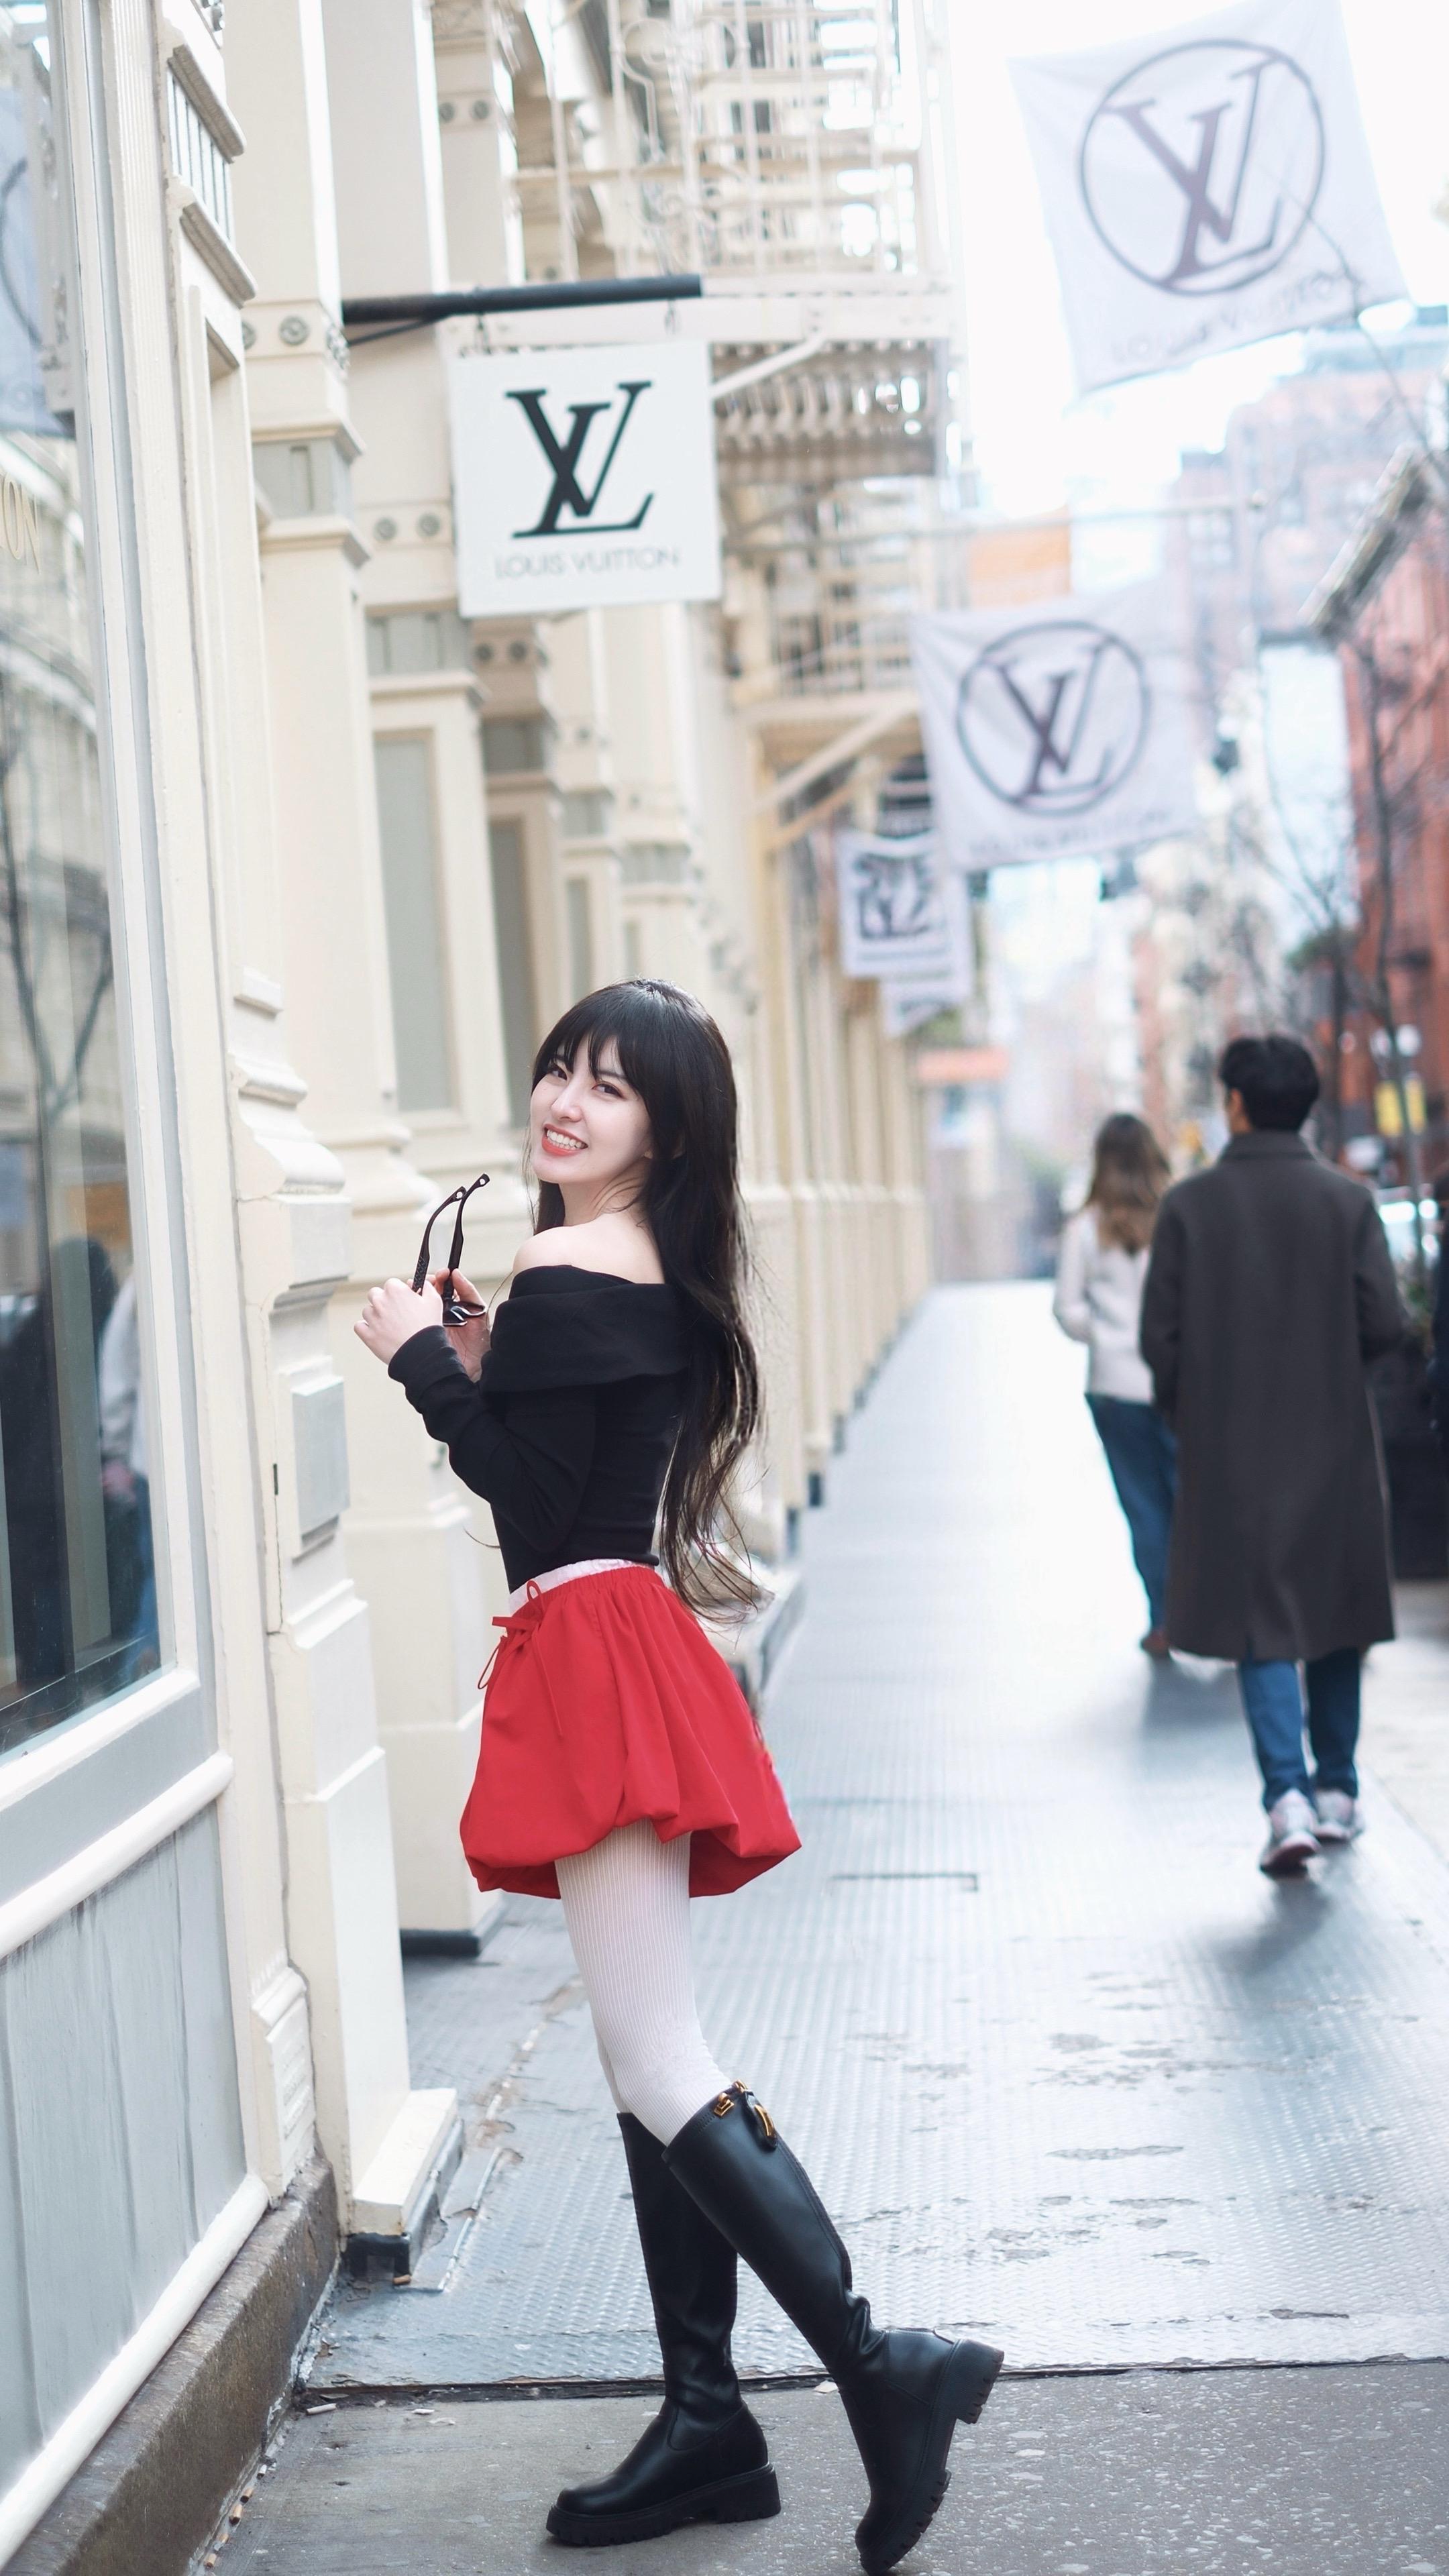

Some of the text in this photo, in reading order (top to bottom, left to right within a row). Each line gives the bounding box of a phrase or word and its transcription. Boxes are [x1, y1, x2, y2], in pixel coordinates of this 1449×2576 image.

[0, 472, 42, 575] ON
[495, 546, 680, 579] LOUIS VUITTON
